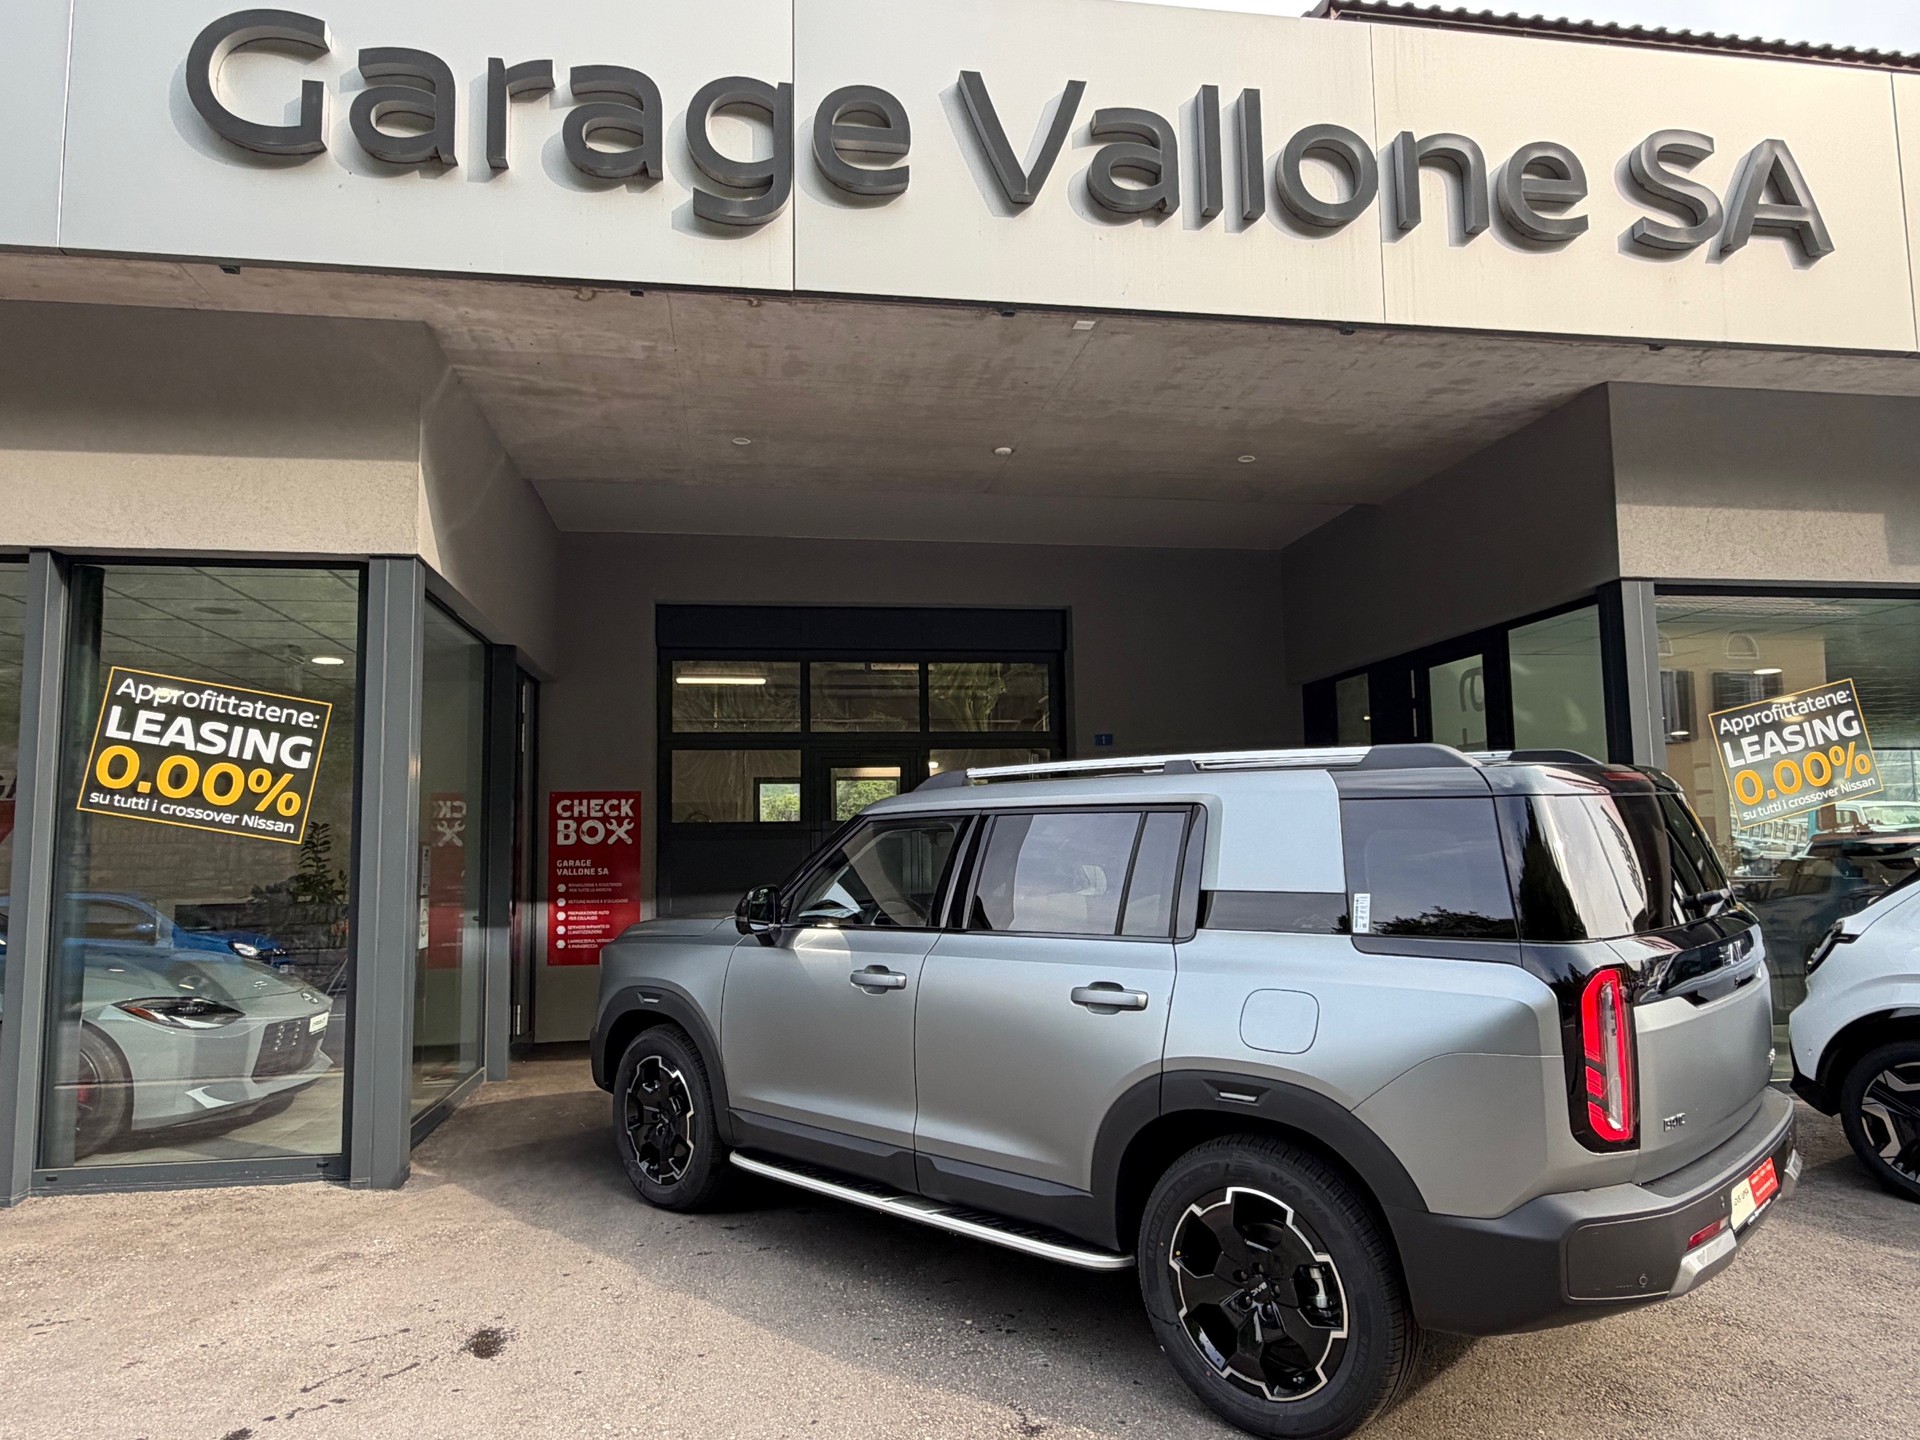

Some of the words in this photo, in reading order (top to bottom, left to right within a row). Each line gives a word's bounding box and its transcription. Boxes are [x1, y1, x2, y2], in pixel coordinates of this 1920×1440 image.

[186, 8, 912, 227] Garage
[958, 70, 1590, 241] Vallone
[1627, 128, 1835, 263] SA
[116, 678, 320, 729] Approfittatene:
[1719, 690, 1852, 735] Approfittatene:
[105, 705, 313, 769] LEASING
[1723, 709, 1861, 769] LEASING
[95, 745, 301, 817] 0.00%
[1734, 741, 1872, 806] 0.00%
[89, 792, 109, 804] su
[113, 794, 149, 811] tutti
[151, 799, 157, 812] i
[160, 803, 239, 824] crossover
[242, 814, 295, 834] Nissan
[556, 798, 635, 818] CHECK
[1742, 809, 1757, 821] su
[1758, 801, 1781, 817] tutti
[1788, 787, 1839, 808] crossover
[1840, 777, 1876, 794] Nissan
[556, 859, 592, 868] GARAGE
[556, 868, 596, 876] VALLONE
[597, 867, 609, 875] SA
